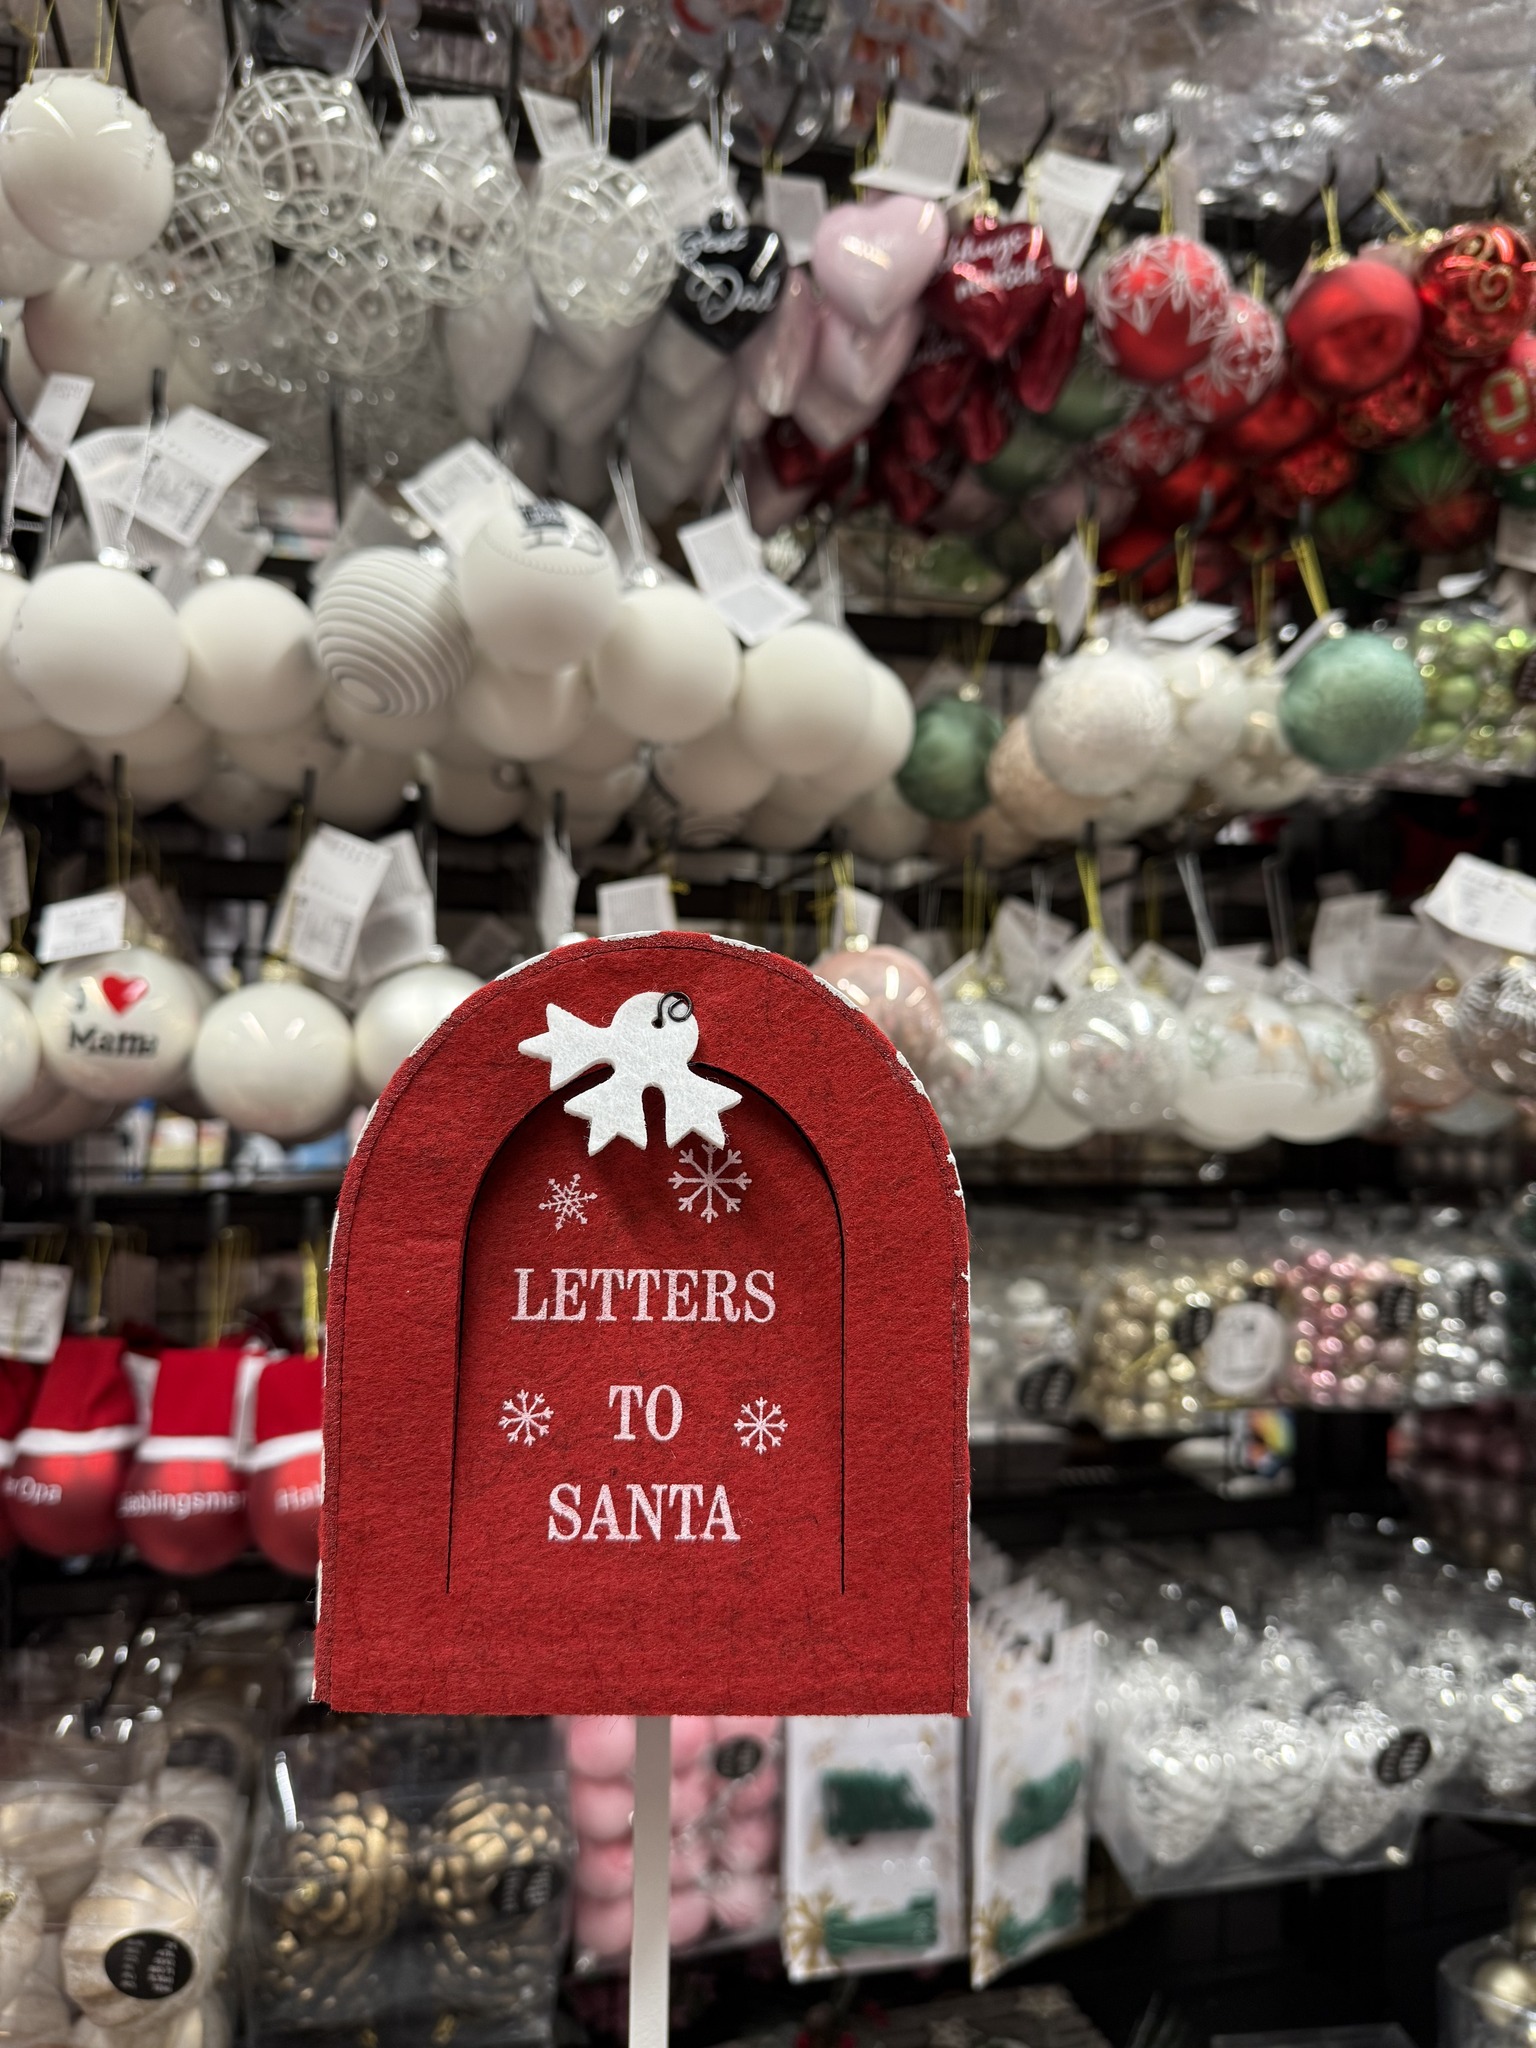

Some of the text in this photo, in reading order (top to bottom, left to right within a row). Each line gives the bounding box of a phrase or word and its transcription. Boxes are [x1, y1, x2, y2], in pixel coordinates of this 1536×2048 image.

[68, 1022, 158, 1057] Mama
[511, 1267, 777, 1324] LETTERS
[608, 1384, 683, 1443] TO
[547, 1482, 742, 1542] SANTA
